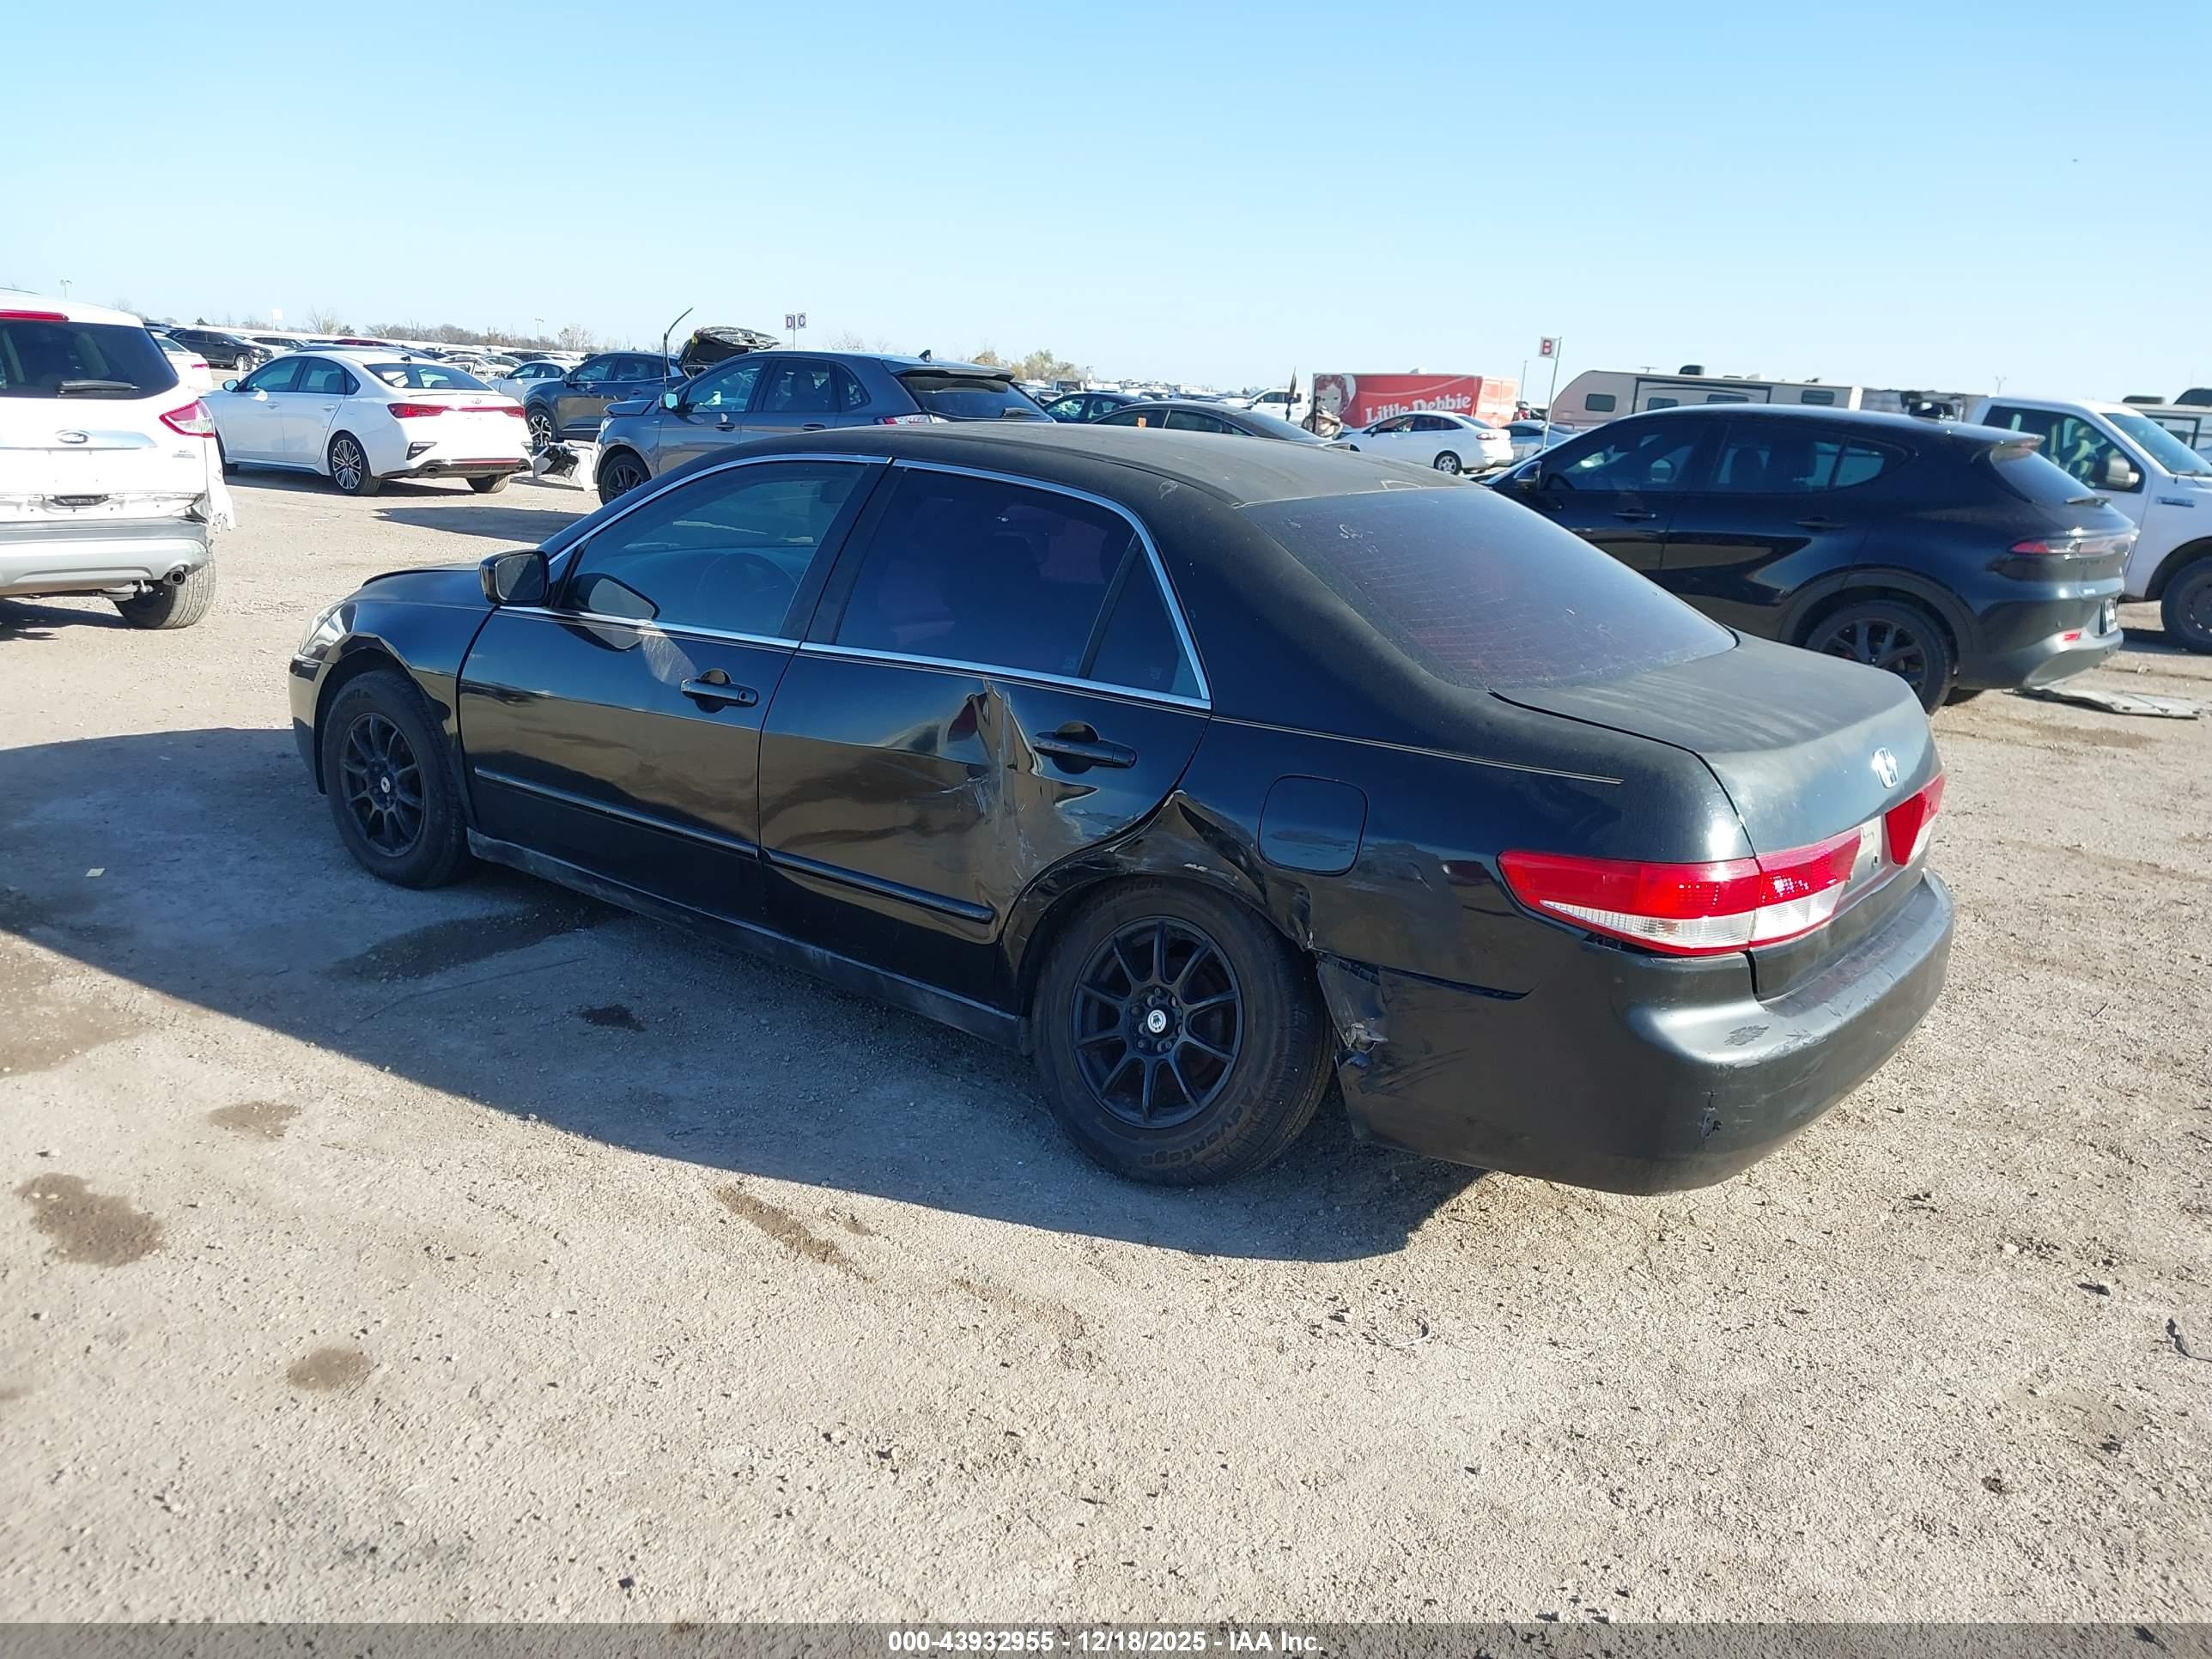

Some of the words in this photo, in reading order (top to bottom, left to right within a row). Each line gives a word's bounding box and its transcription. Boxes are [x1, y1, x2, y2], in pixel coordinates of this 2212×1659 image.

[1542, 339, 1553, 356] B
[1365, 402, 1410, 423] Little
[1412, 392, 1472, 412] Debbie
